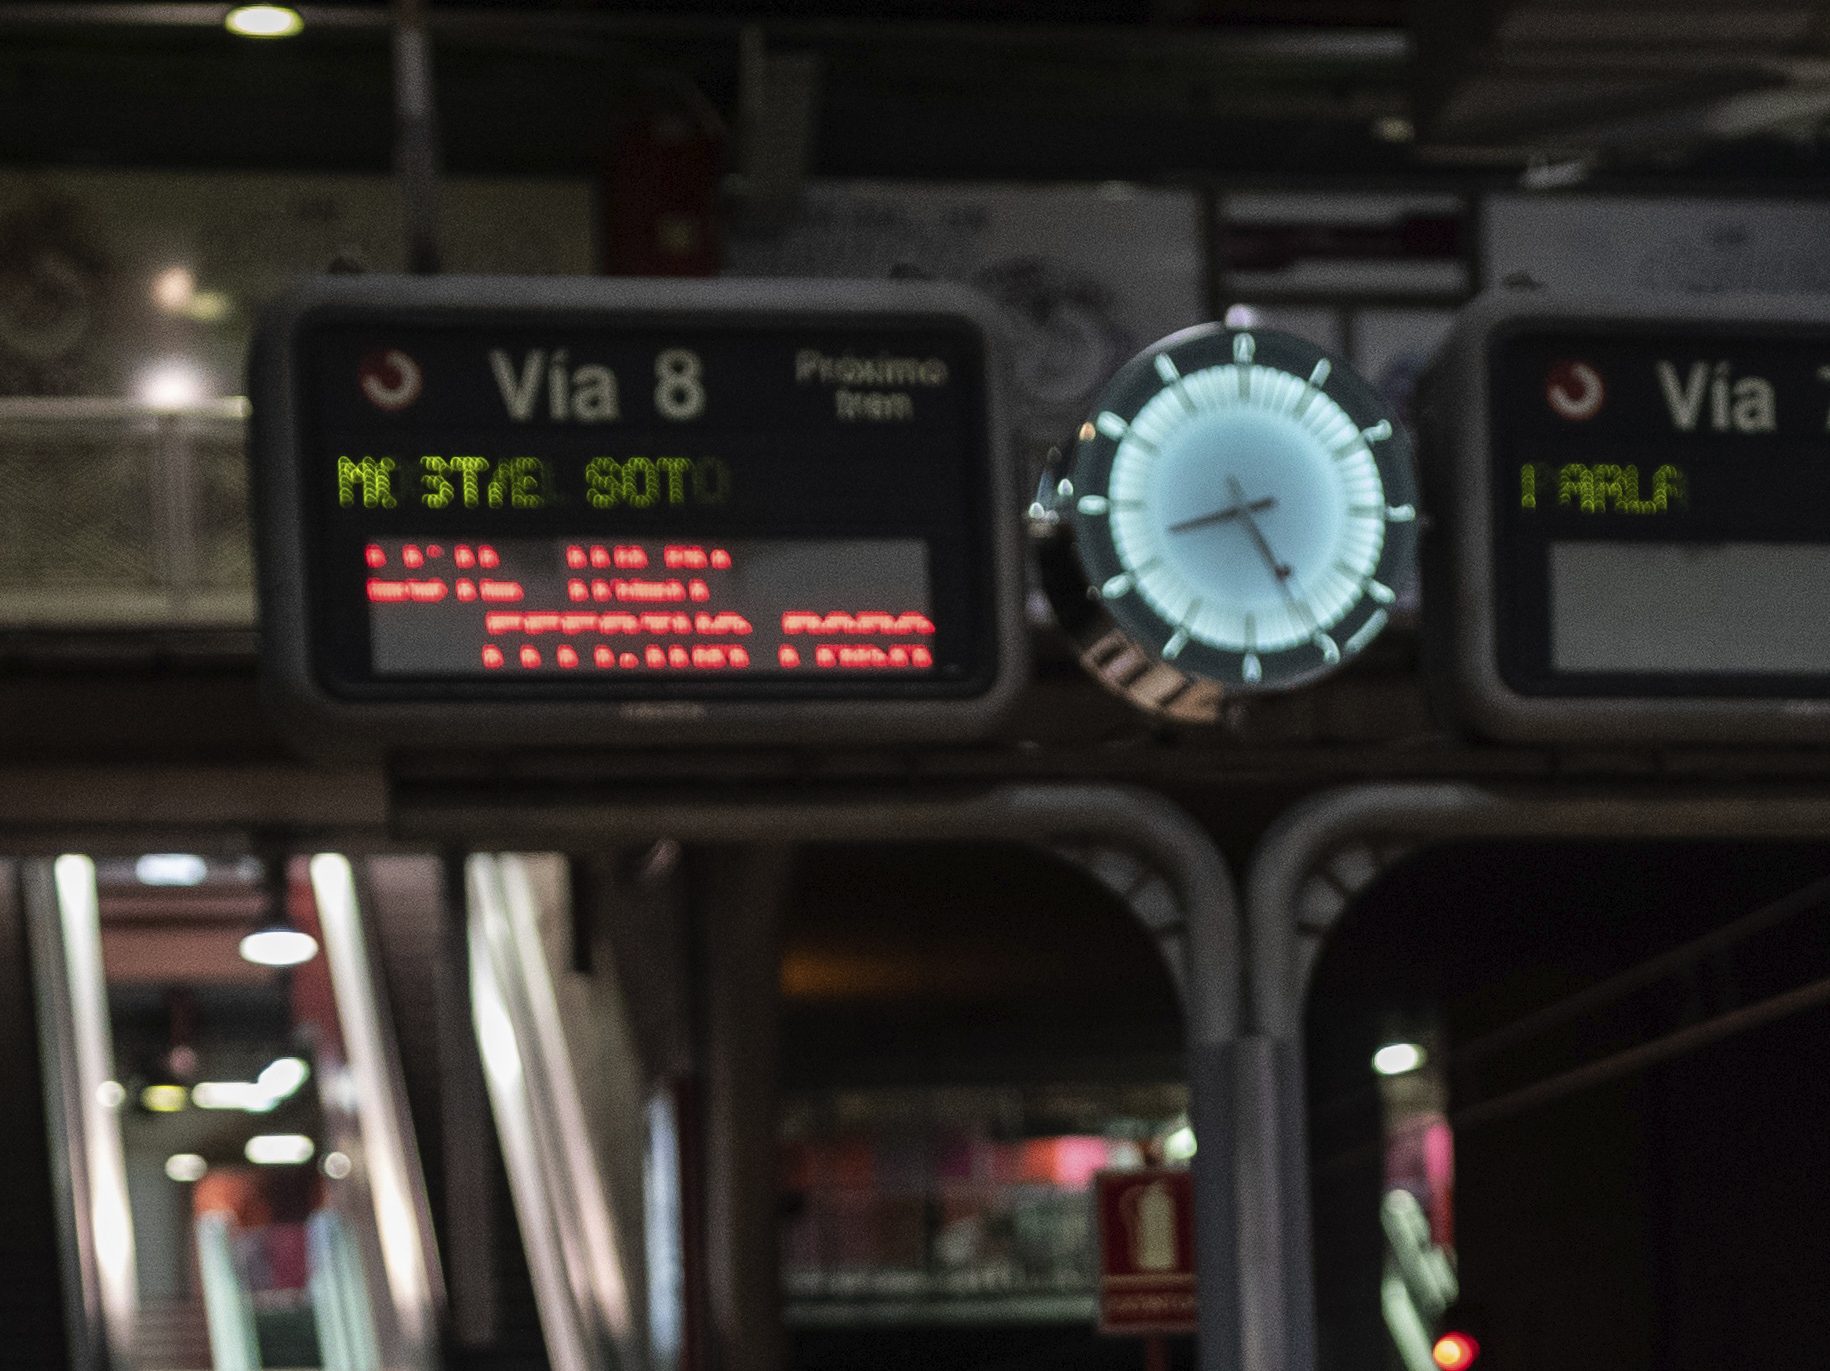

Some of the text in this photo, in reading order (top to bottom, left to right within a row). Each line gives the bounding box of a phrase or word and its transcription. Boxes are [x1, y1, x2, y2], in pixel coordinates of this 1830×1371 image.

[488, 346, 707, 421] Vía 8
[835, 389, 914, 421] tren
[1658, 359, 1777, 433] Vía
